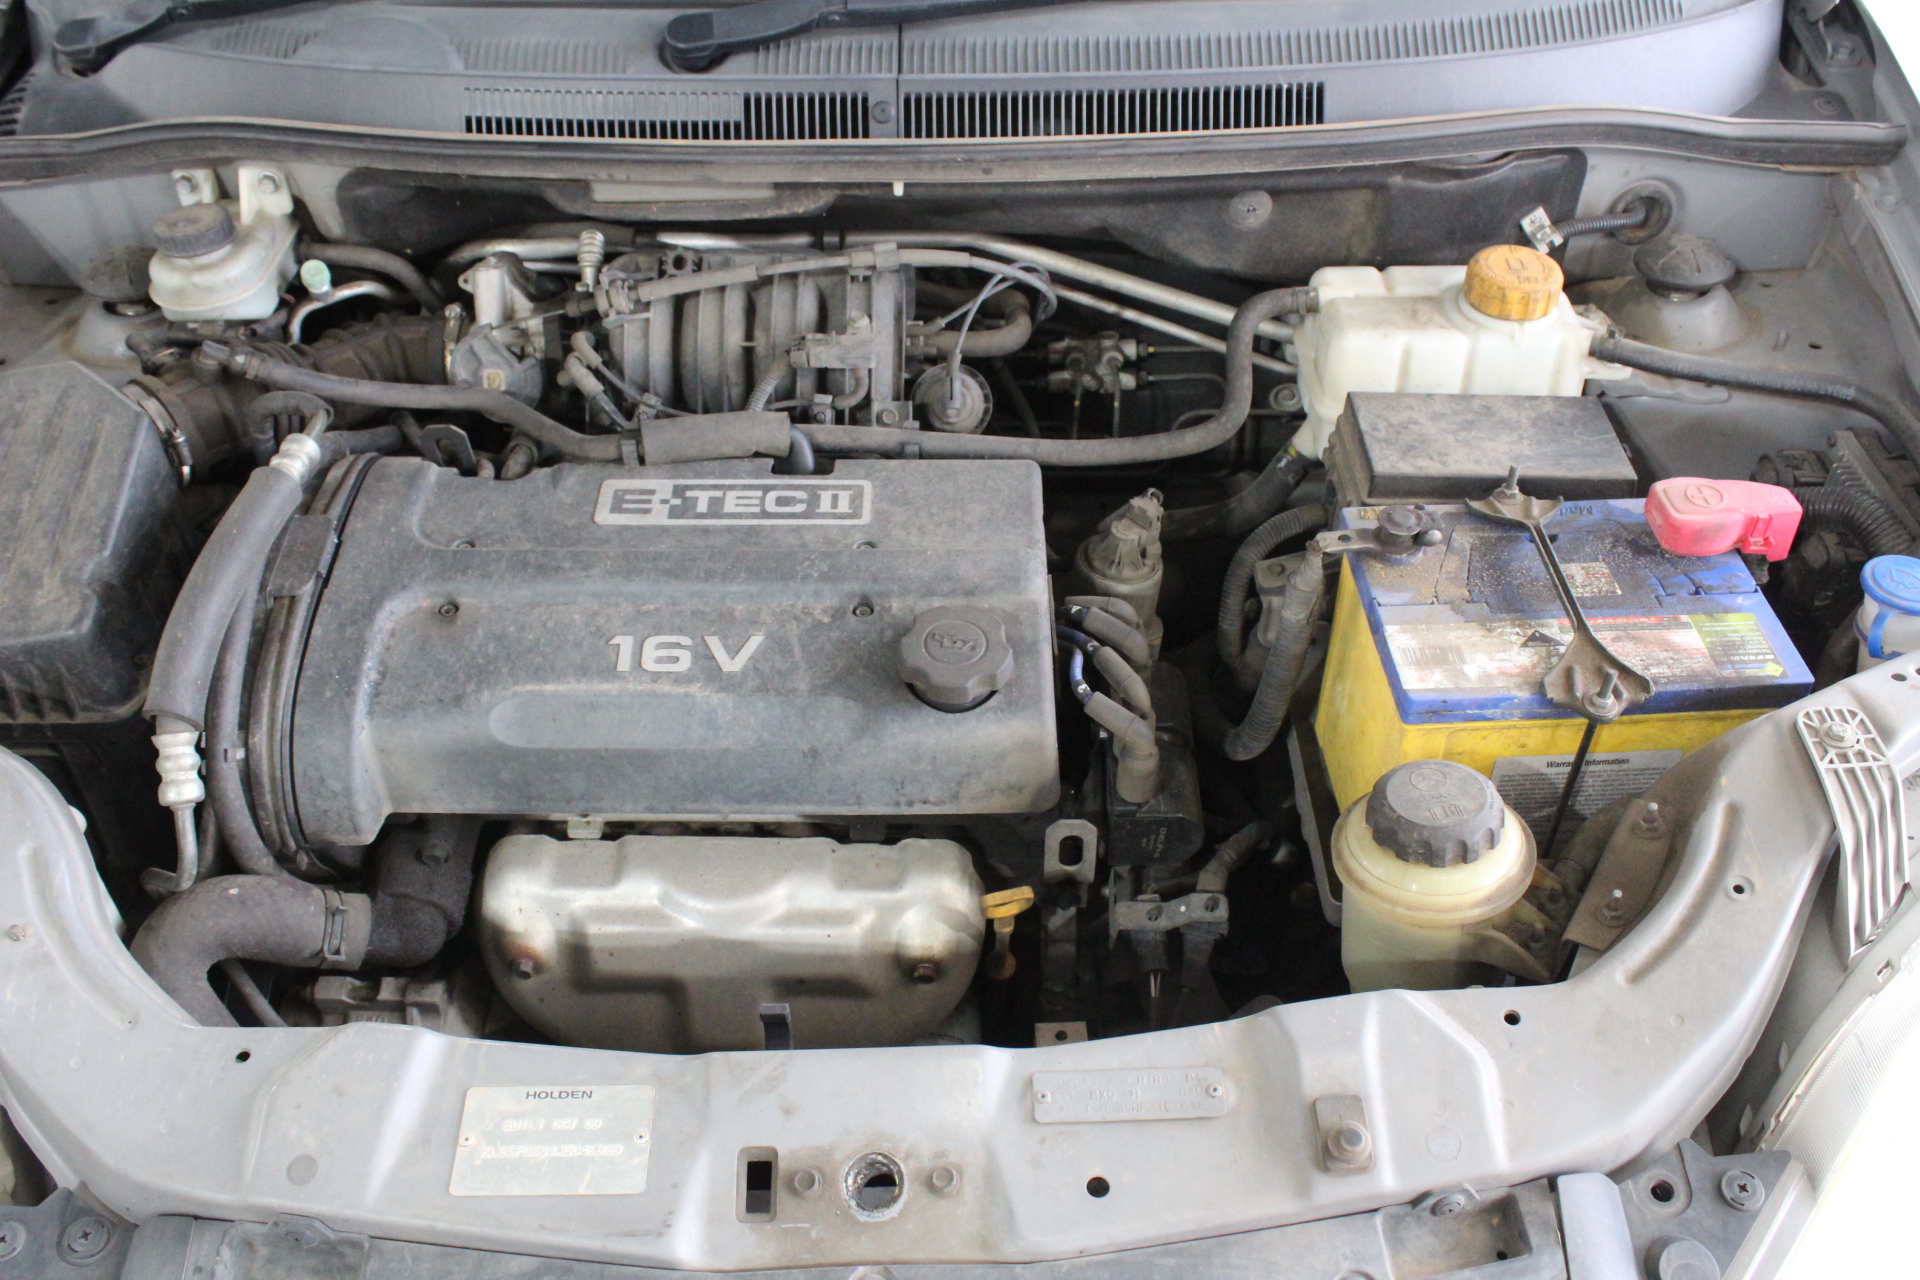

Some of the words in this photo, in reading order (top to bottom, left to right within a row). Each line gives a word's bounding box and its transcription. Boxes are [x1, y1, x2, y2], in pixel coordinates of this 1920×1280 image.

[607, 634, 764, 673] 16V
[1584, 757, 1631, 766] Information
[525, 1090, 594, 1100] HOLDEN
[501, 1118, 545, 1132] BUILT
